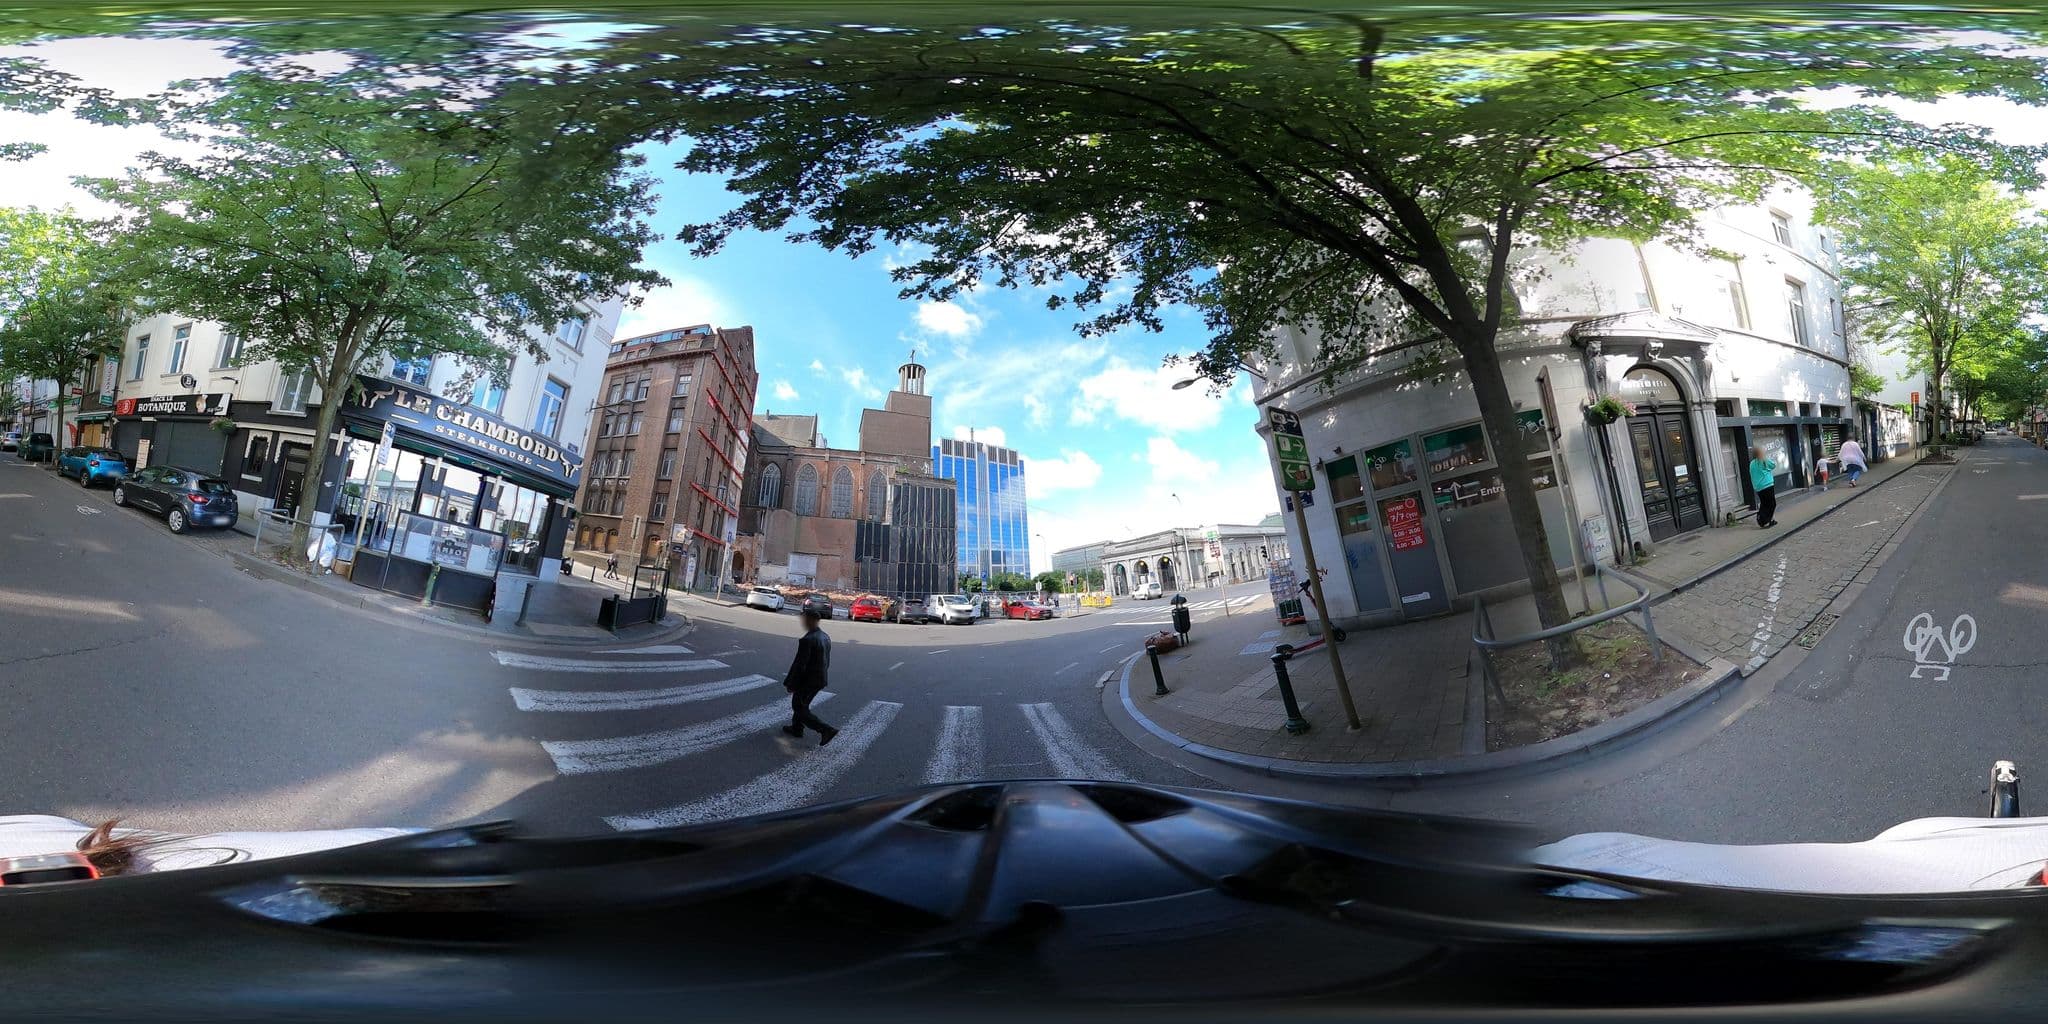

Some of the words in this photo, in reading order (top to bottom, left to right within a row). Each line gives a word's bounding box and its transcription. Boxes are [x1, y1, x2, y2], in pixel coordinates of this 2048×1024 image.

[138, 401, 187, 413] BOTANIQUE
[394, 389, 432, 415] LE
[436, 403, 559, 463] CHAMBORD
[435, 425, 533, 465] STEAKHOUSE
